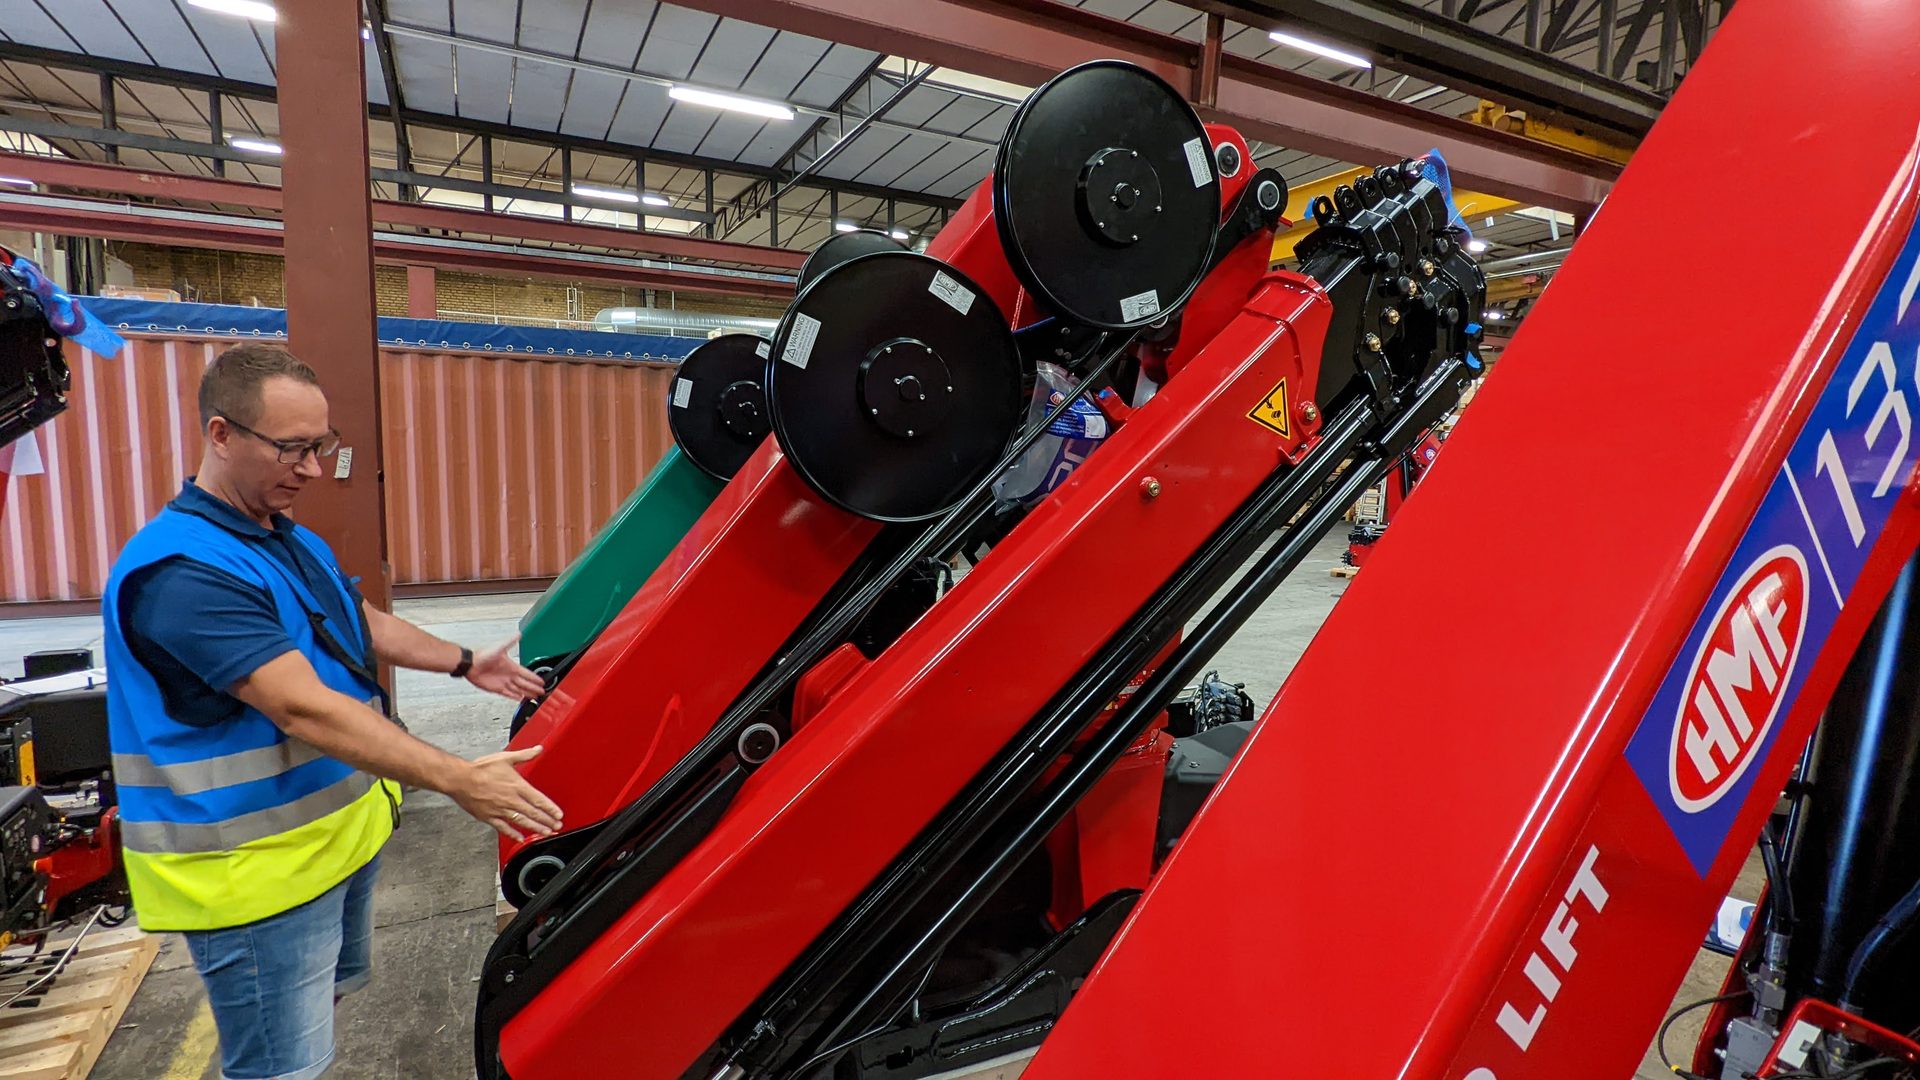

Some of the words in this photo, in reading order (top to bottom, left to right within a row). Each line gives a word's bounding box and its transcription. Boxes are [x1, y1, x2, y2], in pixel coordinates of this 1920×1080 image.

[789, 316, 804, 348] WARNING
[1684, 571, 1788, 785] HMF
[1815, 252, 1920, 549] 13
[1495, 845, 1609, 1052] LIFT
